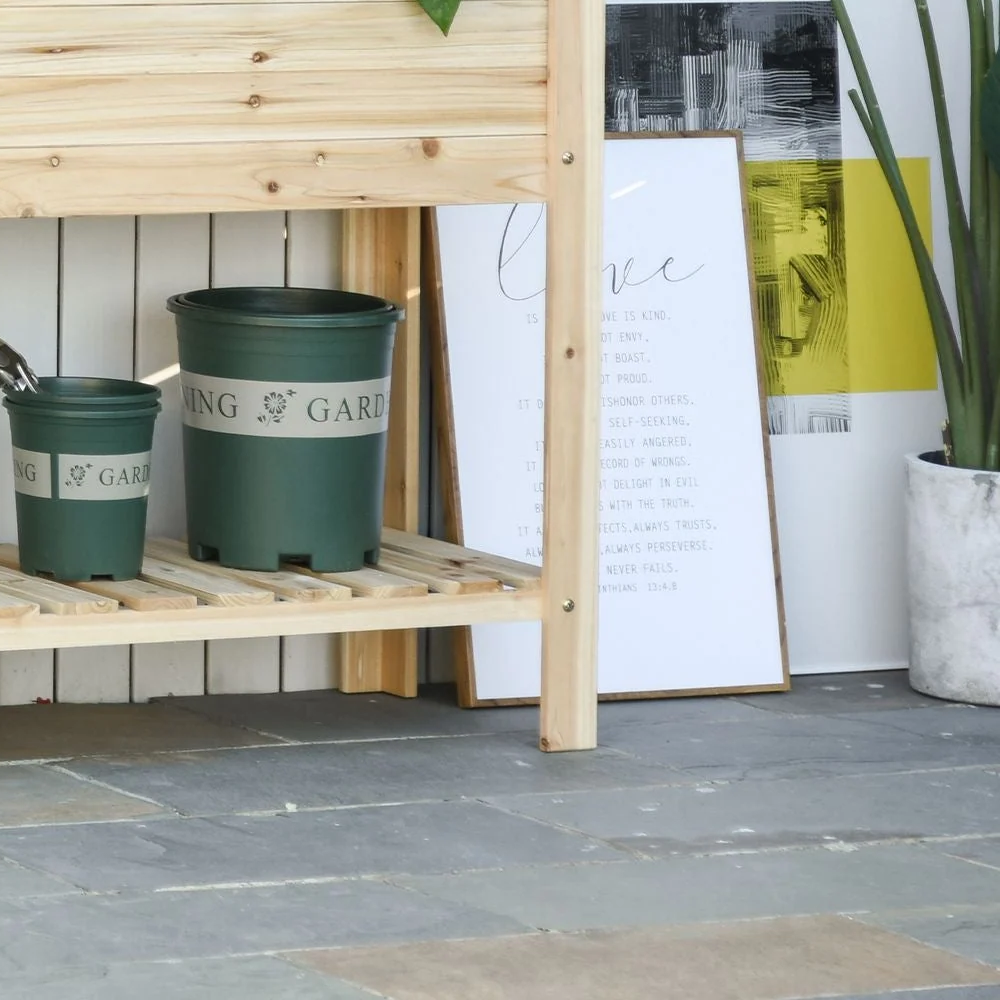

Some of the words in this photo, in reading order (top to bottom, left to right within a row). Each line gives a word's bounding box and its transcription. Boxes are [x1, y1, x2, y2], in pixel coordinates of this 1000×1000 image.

[624, 310, 636, 322] IS
[642, 310, 671, 321] KIND.
[619, 331, 649, 343] ENVY.
[615, 352, 651, 364] BOAST.
[617, 372, 652, 384] PROUD.
[601, 395, 645, 407] ISHONOR
[651, 394, 694, 406] OTHERS.
[307, 393, 388, 423] GARD
[608, 415, 690, 428] SELF-SEEKING.
[642, 436, 692, 448] ANGERED.
[600, 458, 629, 469] ECORD
[634, 457, 646, 468] OF
[651, 456, 691, 468] WRONGS.
[613, 478, 653, 490] DELIGHT
[660, 477, 671, 489] IN
[676, 477, 700, 488] EVIL
[609, 500, 633, 511] WITH
[638, 499, 656, 510] THE
[661, 498, 695, 509] TRUTH.
[606, 564, 638, 576] NEVER
[643, 562, 679, 574] FAILS.
[597, 583, 638, 594] INTHIANS
